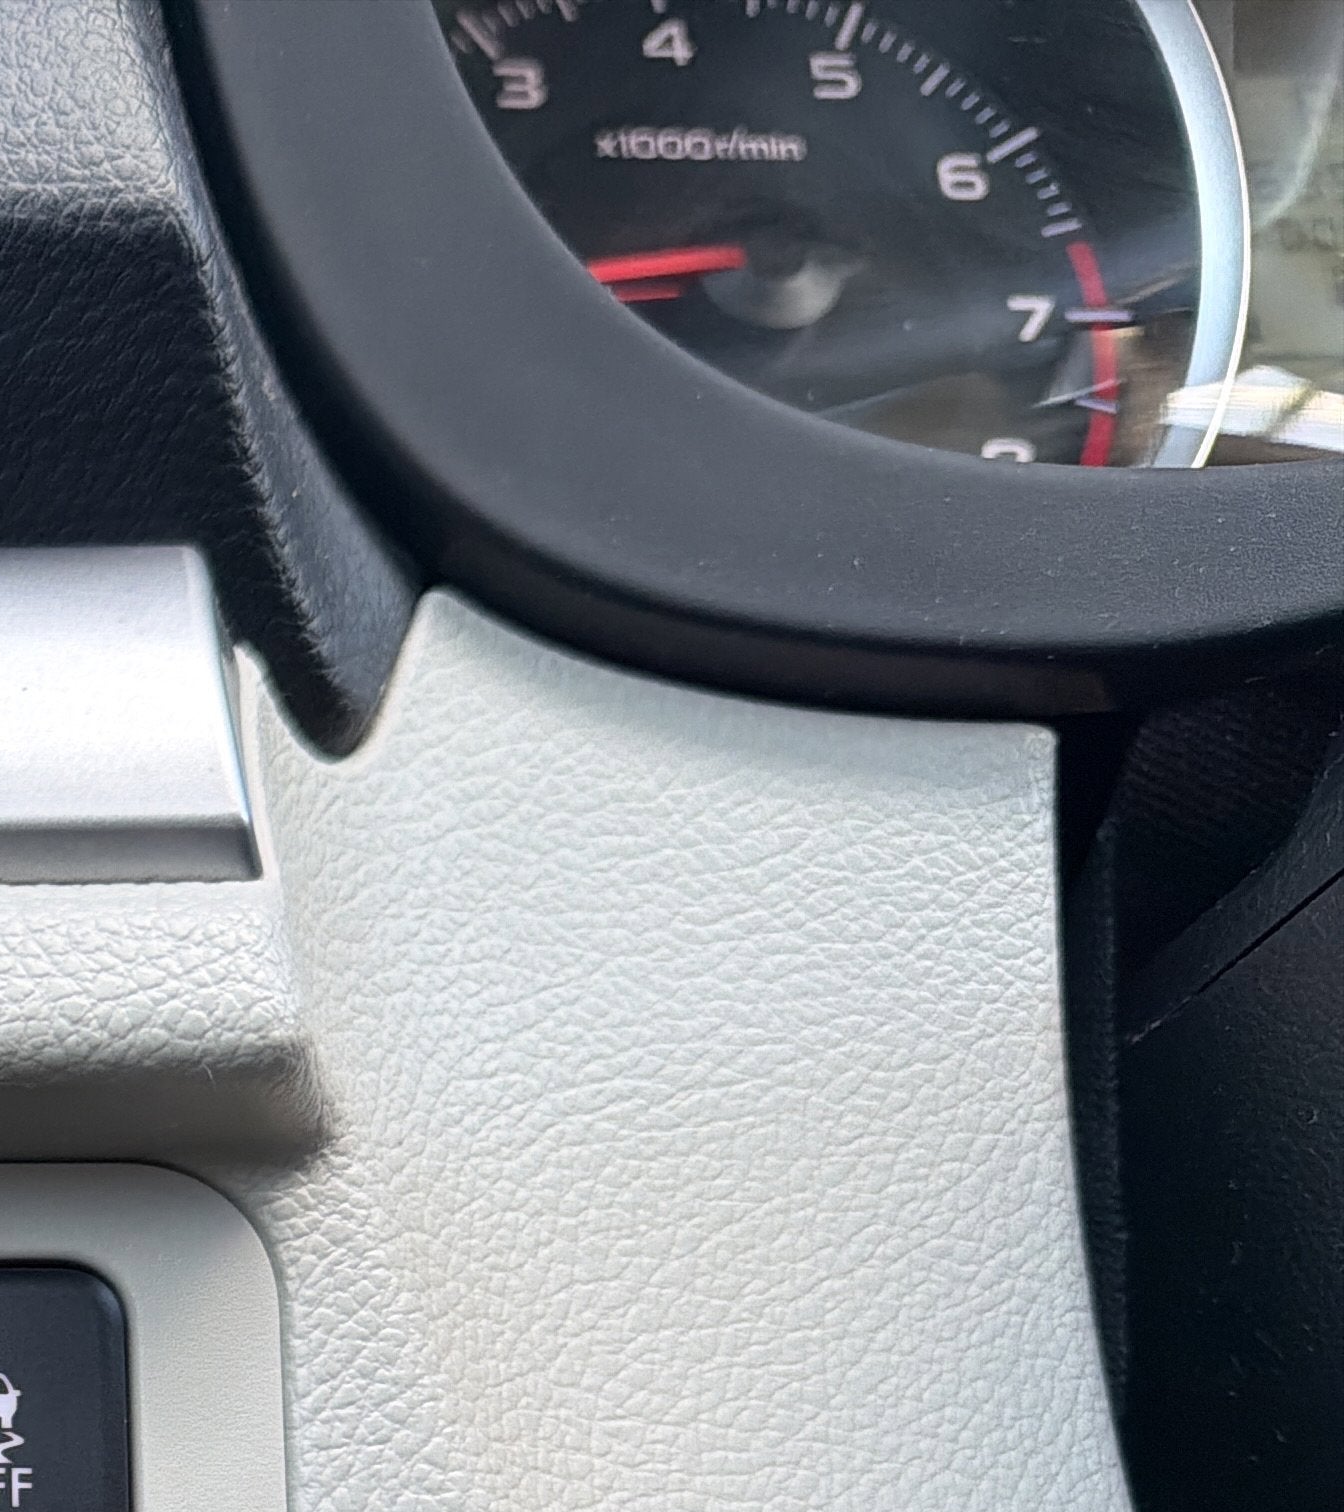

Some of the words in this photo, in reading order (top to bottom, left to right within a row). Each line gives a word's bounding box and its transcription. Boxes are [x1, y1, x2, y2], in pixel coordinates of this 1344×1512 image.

[642, 17, 694, 66] 4
[493, 58, 547, 109] 3
[809, 52, 862, 99] 5
[937, 153, 989, 201] 6
[1006, 295, 1055, 342] 7
